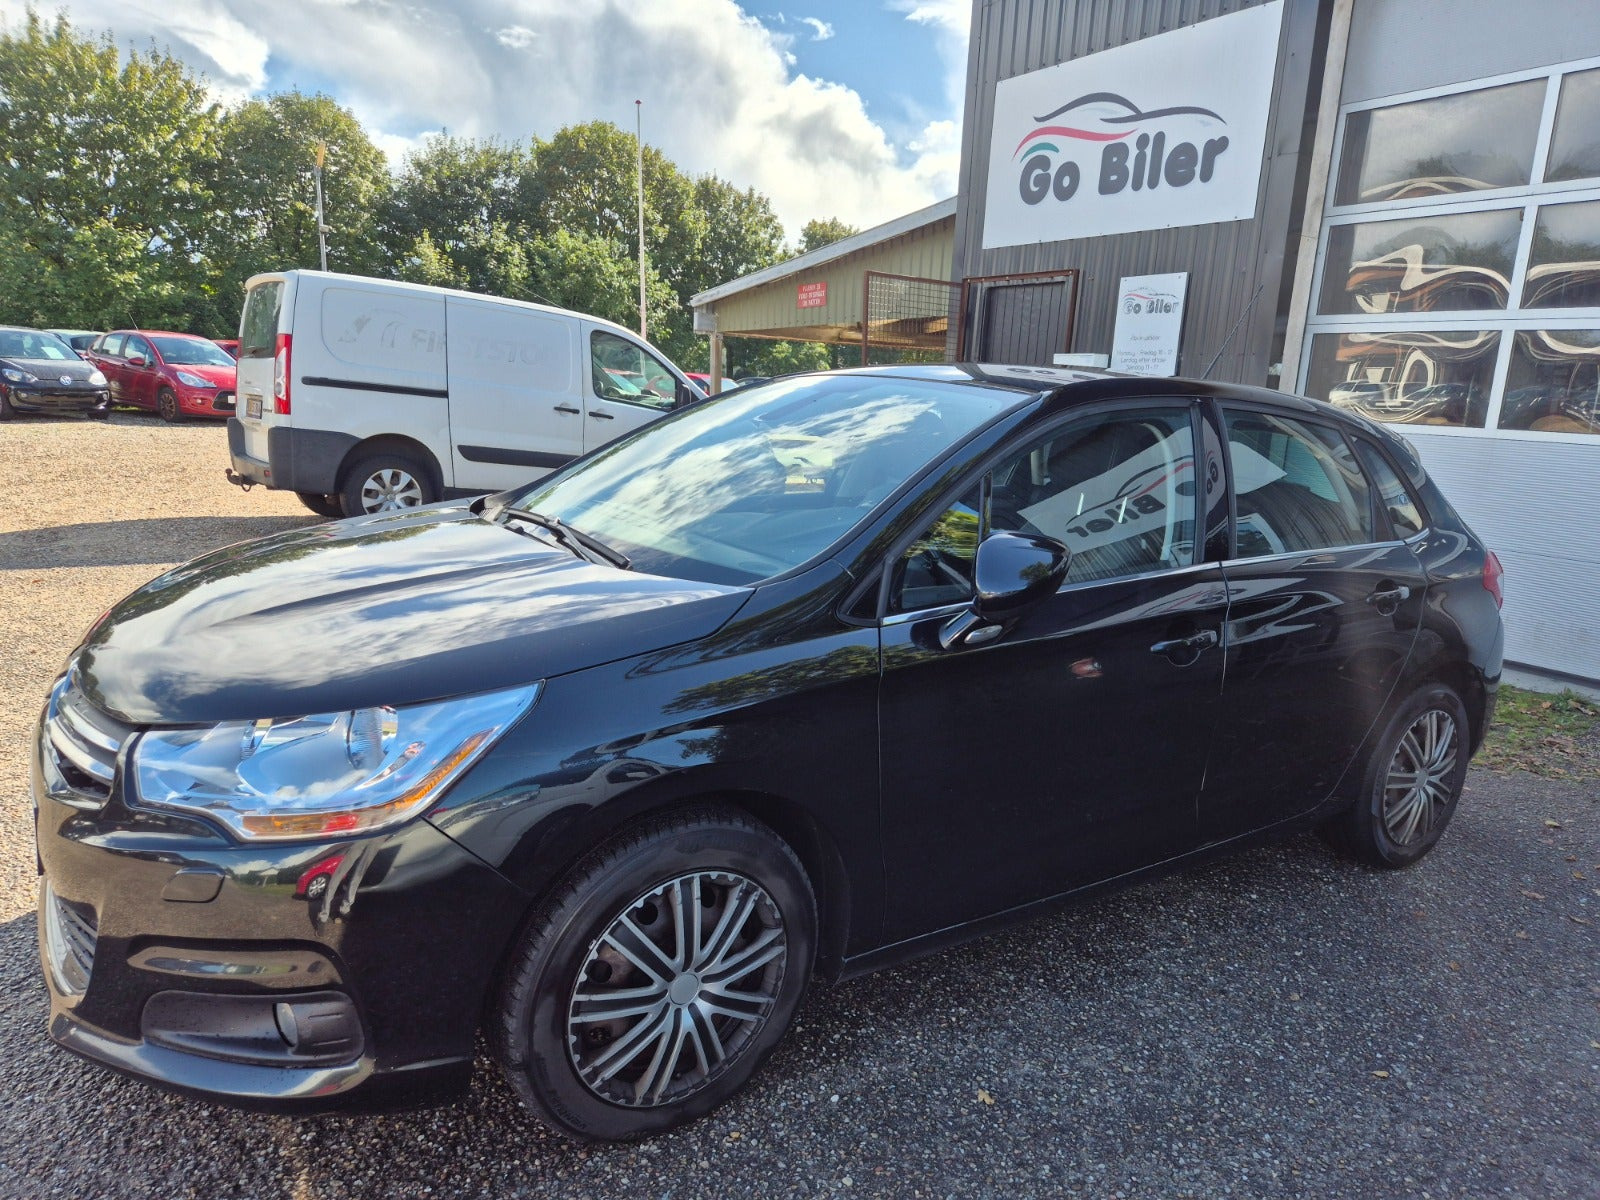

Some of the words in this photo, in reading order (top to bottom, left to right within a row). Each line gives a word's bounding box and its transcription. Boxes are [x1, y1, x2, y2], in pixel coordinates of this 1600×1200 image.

[1019, 154, 1081, 206] Go
[1097, 131, 1230, 196] Biler
[1124, 300, 1141, 314] Go
[1147, 298, 1179, 314] Biler
